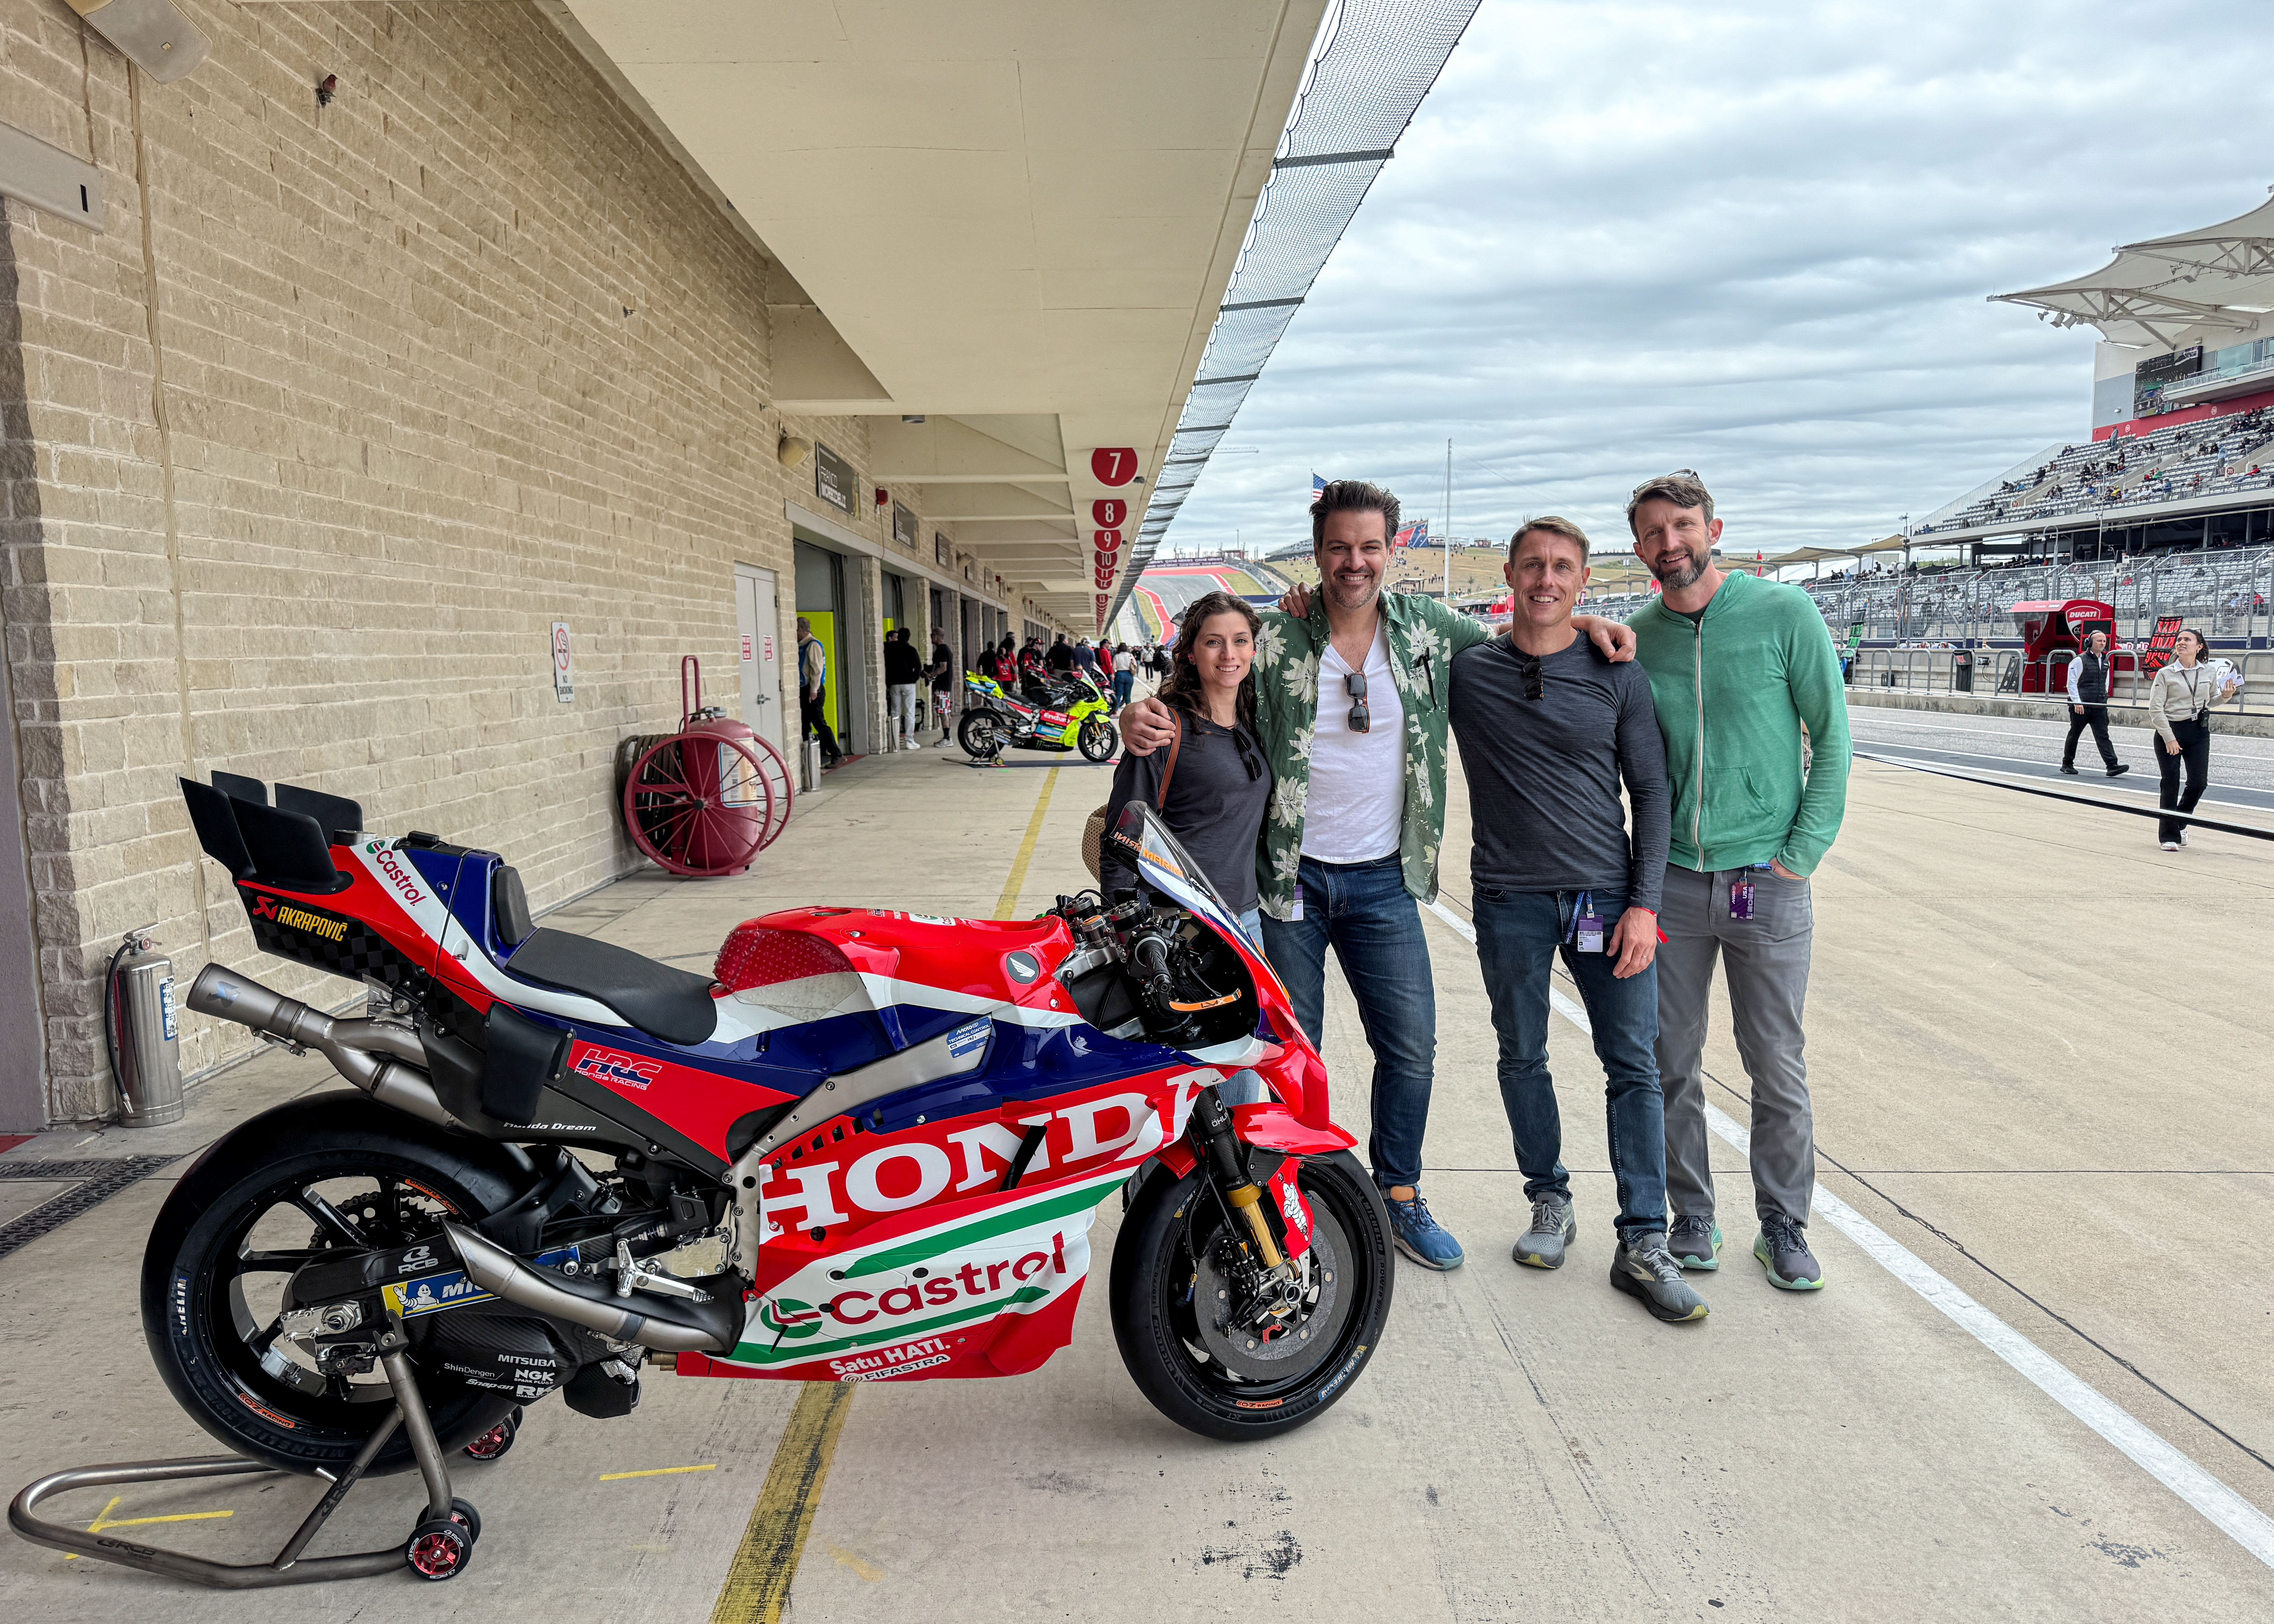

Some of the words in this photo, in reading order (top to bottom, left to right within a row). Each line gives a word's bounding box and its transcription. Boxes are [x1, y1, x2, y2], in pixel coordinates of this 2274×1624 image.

[1110, 453, 1121, 478] 7
[1105, 503, 1114, 523] 8
[1104, 531, 1112, 548] 9
[1100, 552, 1112, 566] 10
[377, 850, 427, 906] Castrol
[949, 1032, 971, 1043] TECHNICAL
[971, 1024, 990, 1034] CONTROL
[576, 1048, 662, 1086] HRC
[574, 1068, 609, 1081] Honda
[610, 1077, 648, 1091] RACING
[551, 1123, 597, 1131] Dream
[398, 1258, 438, 1275] RCB
[830, 1231, 1065, 1324] Castrol
[498, 1354, 556, 1367] MITSUBA
[829, 1356, 883, 1374] Satu
[883, 1338, 951, 1363] HATI.
[444, 1363, 495, 1377] ShinDengen
[515, 1368, 555, 1382] NGK
[865, 1356, 947, 1380] FIFASTRA
[466, 1378, 514, 1390] Snap-on
